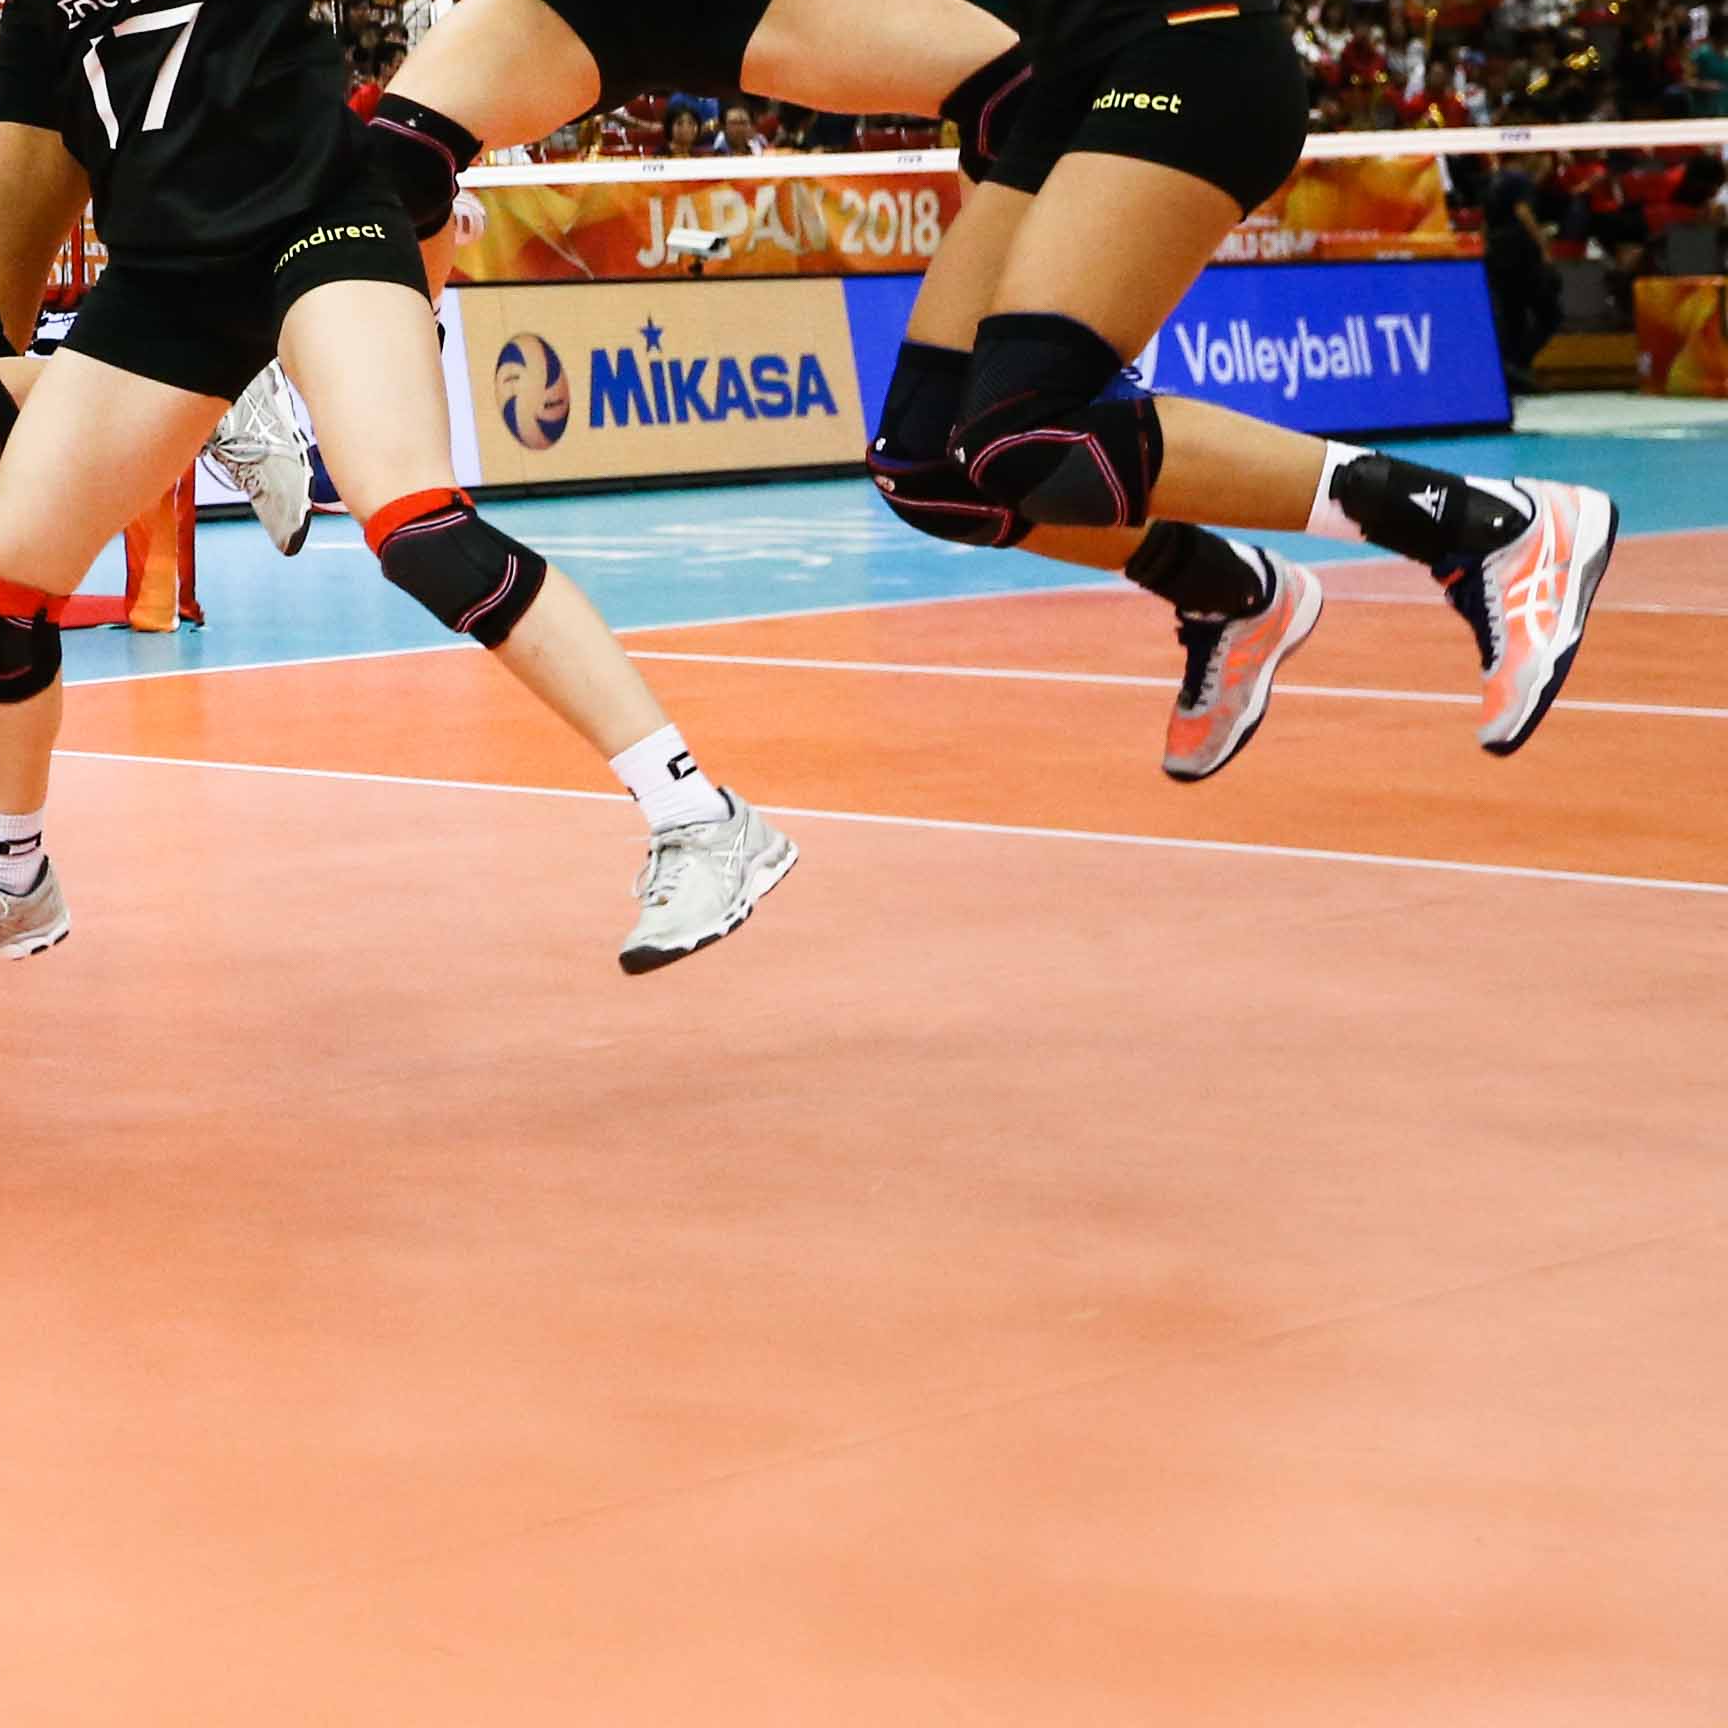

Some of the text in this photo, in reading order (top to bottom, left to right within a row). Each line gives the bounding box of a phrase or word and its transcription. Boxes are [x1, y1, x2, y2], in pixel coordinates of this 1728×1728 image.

[83, 2, 205, 150] 17
[843, 188, 942, 257] 2018
[1175, 311, 1433, 400] Volleyball TV
